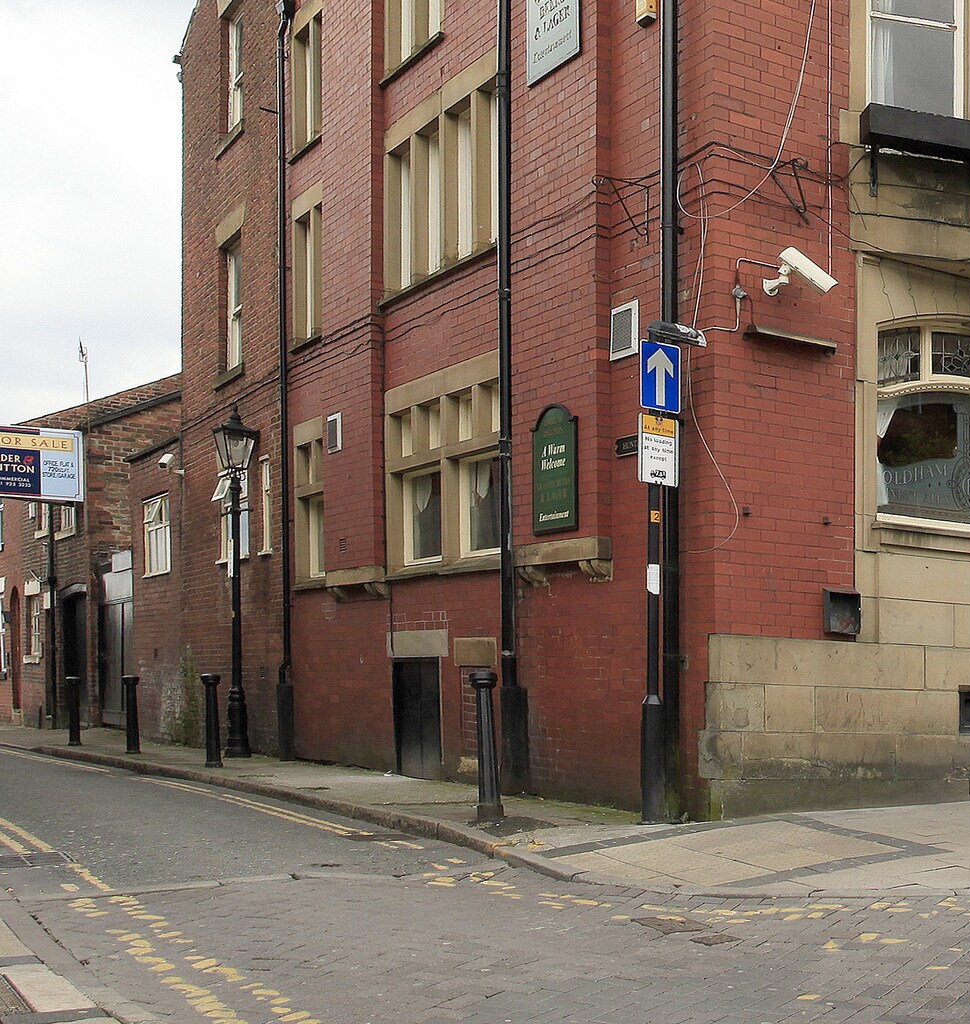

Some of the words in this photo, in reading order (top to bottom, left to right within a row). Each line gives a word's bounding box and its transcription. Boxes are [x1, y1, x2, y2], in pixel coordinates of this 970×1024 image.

[543, 5, 571, 33] LAGER
[0, 436, 22, 446] OR
[31, 439, 67, 448] SALE
[541, 445, 547, 458] A
[548, 443, 566, 456] Warm
[541, 457, 566, 471] Welcome
[882, 463, 948, 485] OLDHAM
[539, 510, 569, 523] Entertainment
